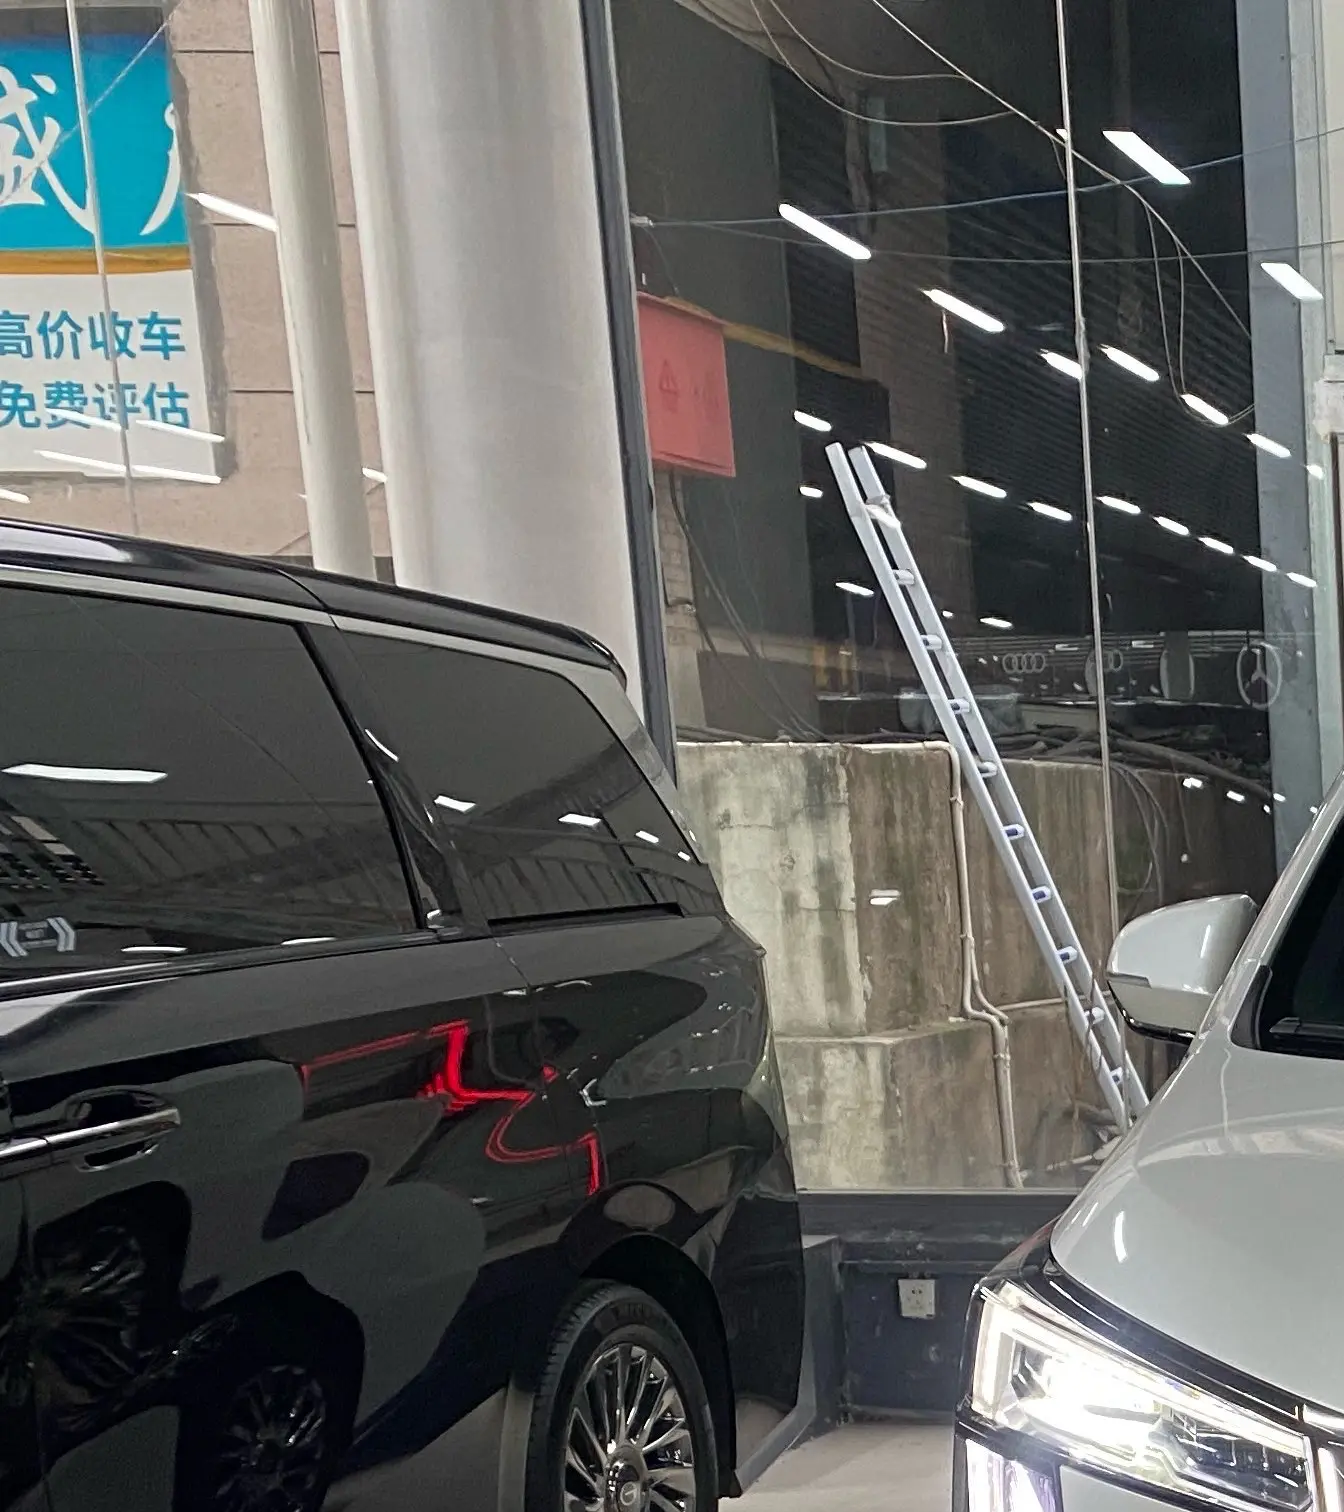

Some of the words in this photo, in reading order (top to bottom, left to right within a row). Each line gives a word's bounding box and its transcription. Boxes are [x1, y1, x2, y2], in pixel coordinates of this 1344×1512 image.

[0, 310, 186, 360] 高价收车
[0, 380, 190, 430] 免费评估
